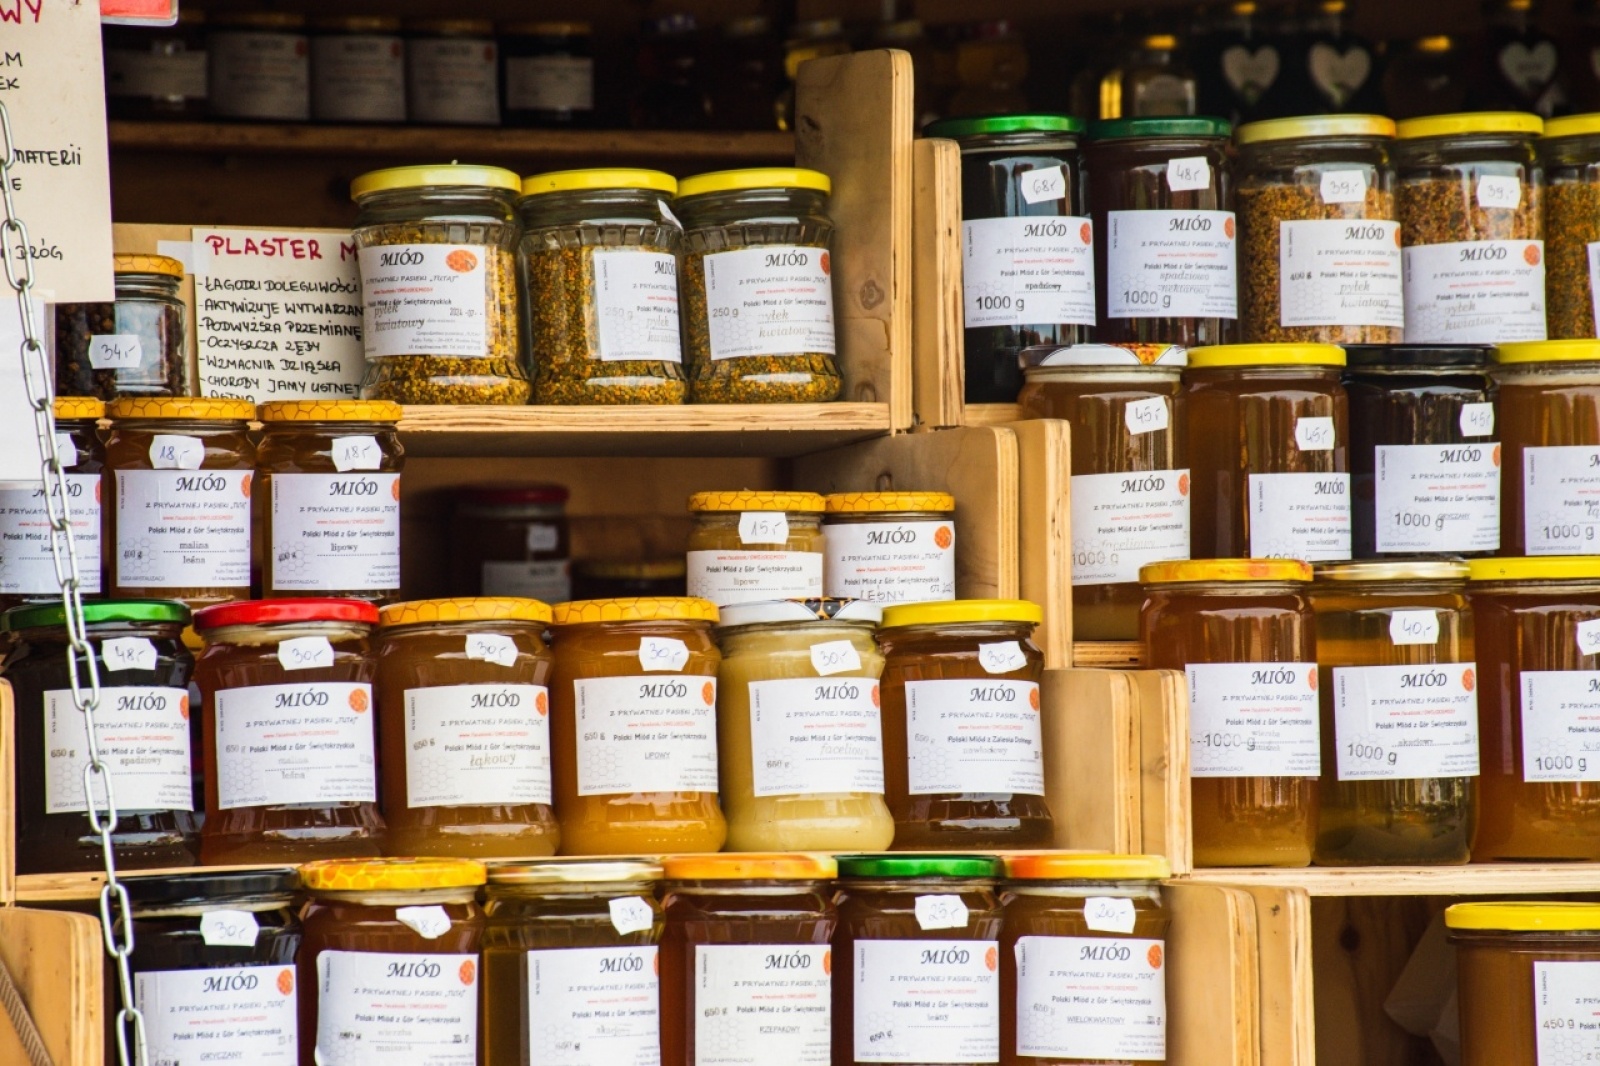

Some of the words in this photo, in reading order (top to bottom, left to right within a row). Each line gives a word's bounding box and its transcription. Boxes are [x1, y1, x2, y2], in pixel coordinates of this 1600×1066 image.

[1024, 220, 1067, 237] MIÓD
[1169, 215, 1211, 231] MIÓD
[1344, 224, 1385, 240] MIÓD
[205, 235, 323, 260] PLASTER
[1460, 247, 1507, 262] MIÓD
[380, 249, 424, 267] MIÓD
[765, 250, 808, 267] MIÓD
[1025, 282, 1061, 292] spadziowy
[975, 296, 1011, 310] 1000
[1016, 297, 1025, 311] g
[1123, 290, 1158, 304] 1000
[1162, 292, 1171, 307] g
[605, 307, 624, 318] 250
[626, 310, 633, 320] g
[712, 307, 729, 318] 250
[732, 308, 739, 318] g
[207, 336, 279, 351] OCZYSZCZA
[206, 355, 275, 370] WZMACNIA
[208, 375, 260, 389] CHOROBY
[268, 379, 306, 392] JAMY
[1439, 446, 1481, 463] MIÓD
[176, 474, 226, 492] MIÓD
[329, 477, 378, 496] MIÓD
[1121, 474, 1165, 493] MIÓD
[1314, 478, 1345, 495] MIÓD
[1395, 513, 1430, 527] 1000
[1436, 516, 1445, 531] g
[866, 526, 916, 546] MIÓD
[1543, 526, 1580, 539] 1000
[1585, 526, 1595, 540] g
[179, 541, 209, 549] malina
[848, 554, 891, 562] PRYWATNEJ
[845, 578, 860, 586] Polski
[862, 577, 876, 585] Miód
[1251, 667, 1296, 684] MIÓD
[1401, 670, 1447, 688] MIÓD
[640, 680, 687, 699] MIÓD
[815, 682, 859, 700] MIÓD
[970, 685, 1016, 702] MIÓD
[118, 692, 167, 711] MIÓD
[275, 688, 329, 709] MIÓD
[471, 690, 520, 708] MIÓD
[1204, 734, 1242, 747] 1000
[1247, 737, 1256, 751] g
[470, 753, 516, 768] łąkowy
[645, 752, 670, 760] LIPOWY
[1347, 744, 1383, 760] 1000
[1388, 751, 1397, 765] g
[1536, 756, 1573, 770] 1000
[1578, 758, 1587, 771] g
[765, 951, 811, 969] MIÓD
[921, 947, 970, 964] MIÓD
[1080, 943, 1131, 961] MIÓD
[387, 959, 441, 978] MIÓD
[600, 953, 643, 972] MIÓD
[203, 971, 258, 992] MIÓD
[1067, 1016, 1125, 1024] WIELOKWIATOWY
[1544, 1018, 1564, 1029] 450
[1568, 1019, 1574, 1029] g
